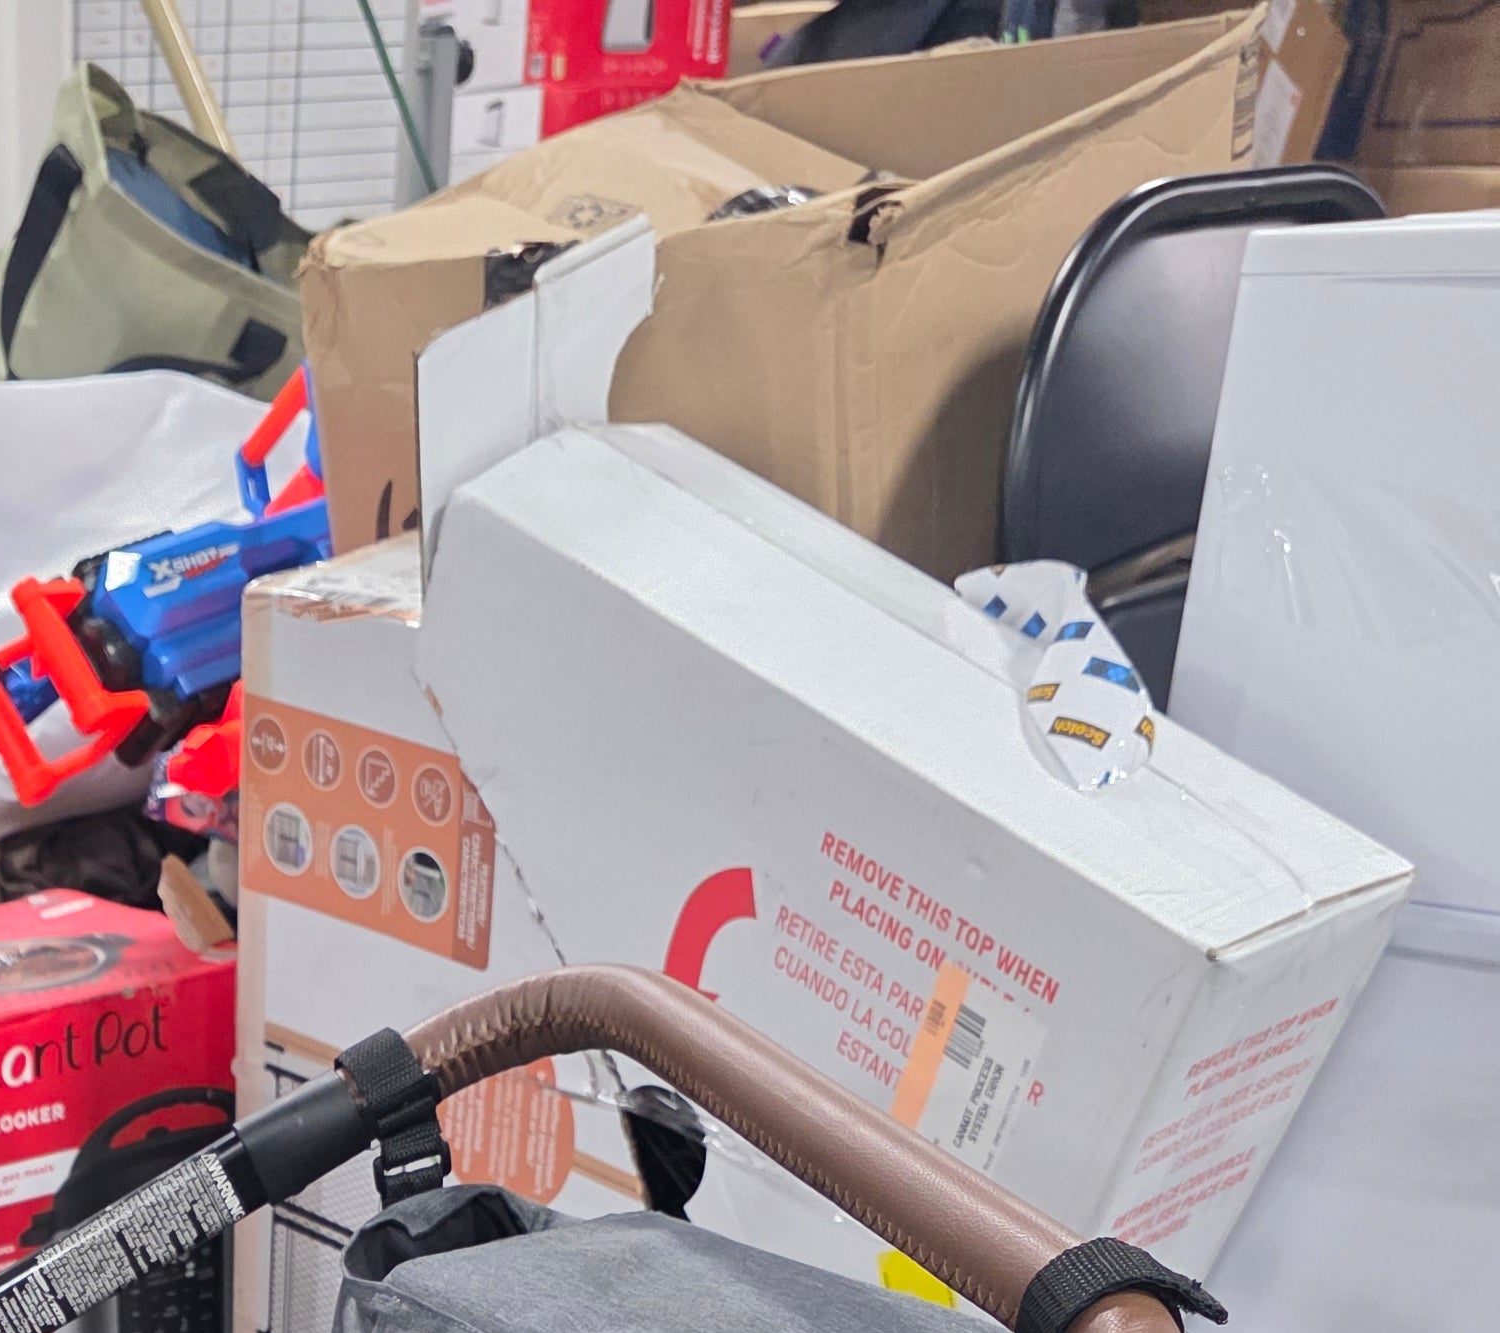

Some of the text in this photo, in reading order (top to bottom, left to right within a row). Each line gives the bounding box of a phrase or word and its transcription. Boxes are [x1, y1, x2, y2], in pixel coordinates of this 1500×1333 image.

[1053, 717, 1109, 746] Scotch
[820, 831, 904, 901] REMOVE
[905, 884, 952, 932] THIS
[954, 917, 995, 957] TOP
[996, 945, 1060, 1004] WHEN
[829, 879, 947, 973] PLACING ON
[773, 945, 850, 1012] CUANDO
[850, 999, 873, 1032] LA
[775, 904, 839, 964] RETIRE
[839, 948, 885, 995] ESTA
[887, 981, 925, 1022] PAR
[94, 1003, 168, 1066] Pot
[836, 1030, 905, 1091] ESTANT
[205, 1161, 247, 1220] WARNING
